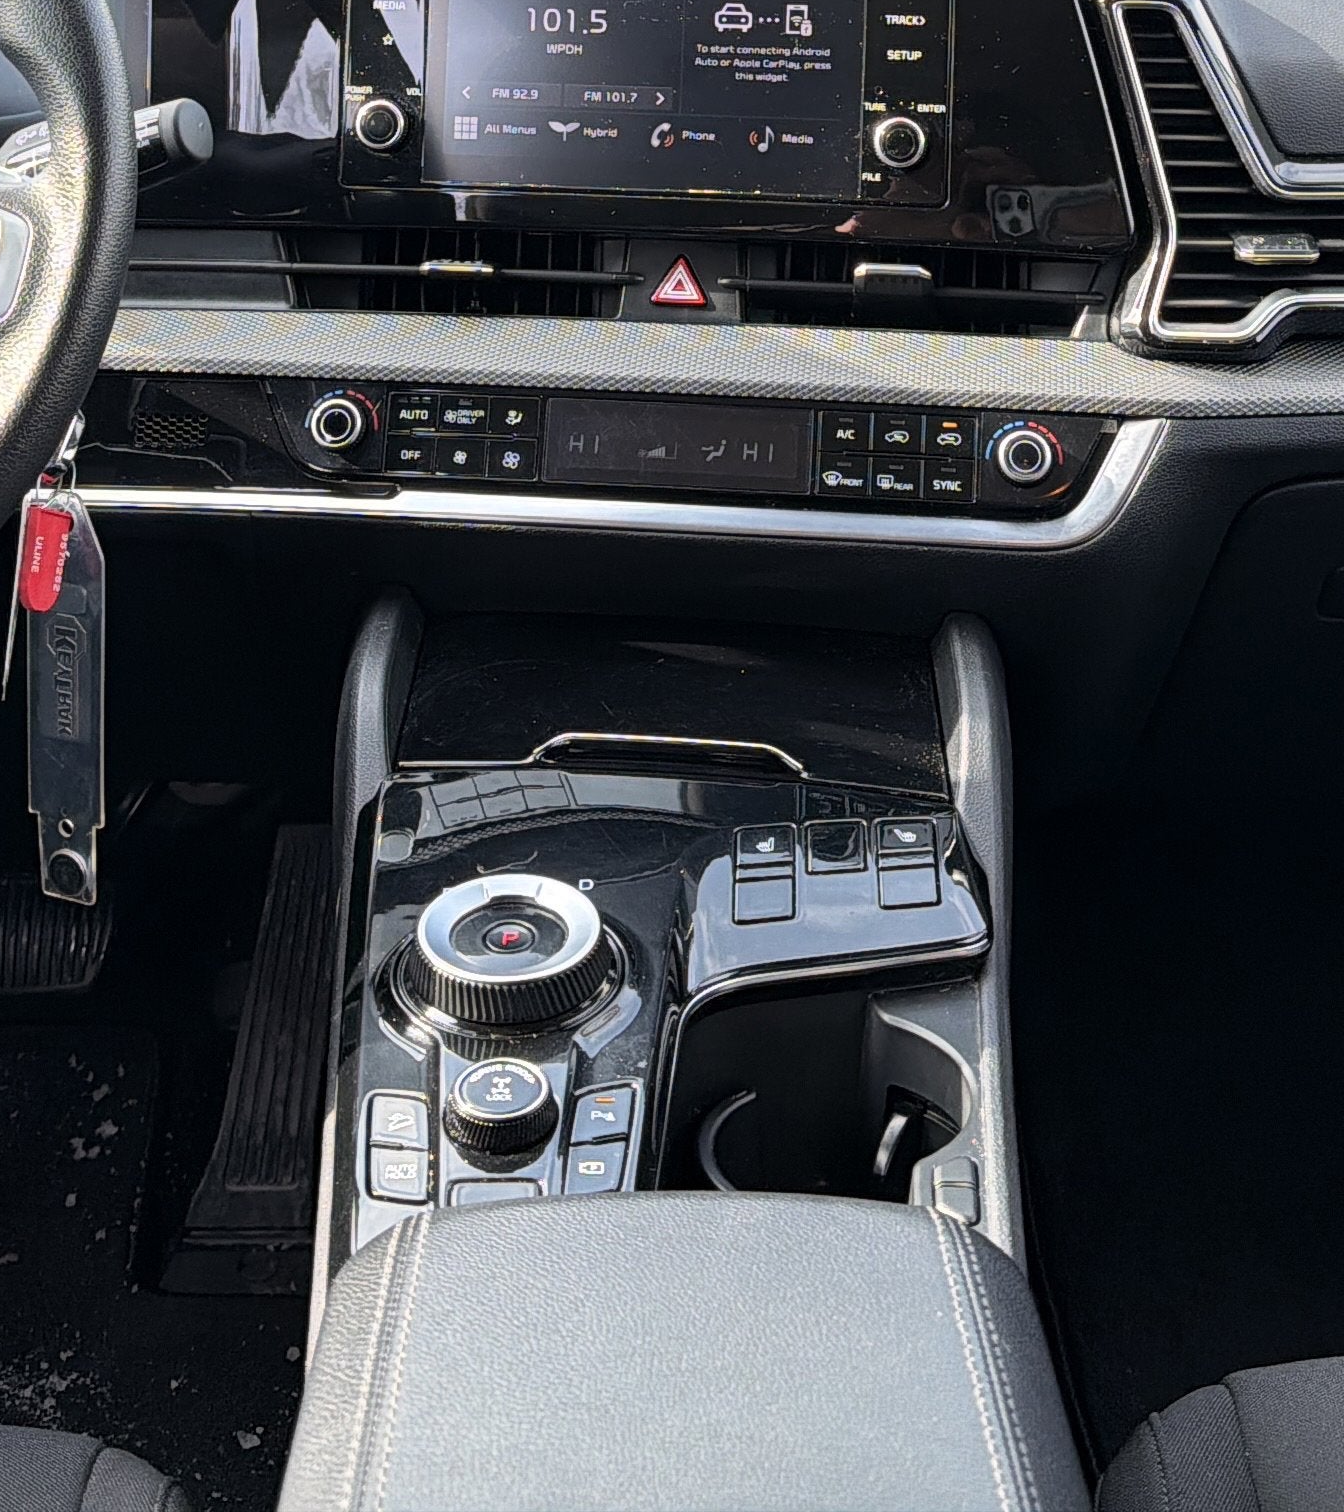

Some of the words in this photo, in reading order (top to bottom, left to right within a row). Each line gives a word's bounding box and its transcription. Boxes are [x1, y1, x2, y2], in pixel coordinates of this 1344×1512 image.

[373, 0, 406, 11] MEDIA
[527, 7, 608, 35] 101.5
[546, 43, 583, 55] WPDH
[696, 43, 708, 53] To
[710, 45, 735, 54] start
[736, 45, 791, 56] connecting
[792, 46, 831, 56] Android
[886, 50, 923, 61] SETUP
[694, 57, 718, 67] Auto
[720, 59, 731, 67] or
[733, 58, 761, 69] Apple
[803, 62, 832, 72] press
[735, 71, 754, 81] this
[406, 86, 423, 97] VOL
[492, 88, 510, 99] FM
[512, 89, 539, 100] 92.9
[583, 91, 602, 103] FM
[605, 92, 639, 104] 101.7
[864, 102, 887, 112] TUNE
[916, 103, 947, 114] ENTER
[484, 124, 501, 134] All
[502, 124, 537, 135] Menus
[583, 126, 618, 139] Hybrid
[681, 130, 716, 141] Phone
[782, 133, 814, 144] Media
[861, 172, 882, 182] FILE
[399, 408, 429, 420] AUTO
[457, 409, 485, 418] DRIVER
[836, 428, 855, 440] A/C
[400, 450, 422, 461] OFF
[840, 478, 864, 487] FRONT
[894, 482, 914, 491] REAR
[932, 479, 963, 492] SYNC
[30, 536, 45, 574] ULINE
[578, 878, 595, 890] D
[501, 930, 520, 947] P
[485, 1093, 513, 1102] LOCK
[385, 1163, 418, 1172] AUTO
[384, 1171, 418, 1180] HOLD
